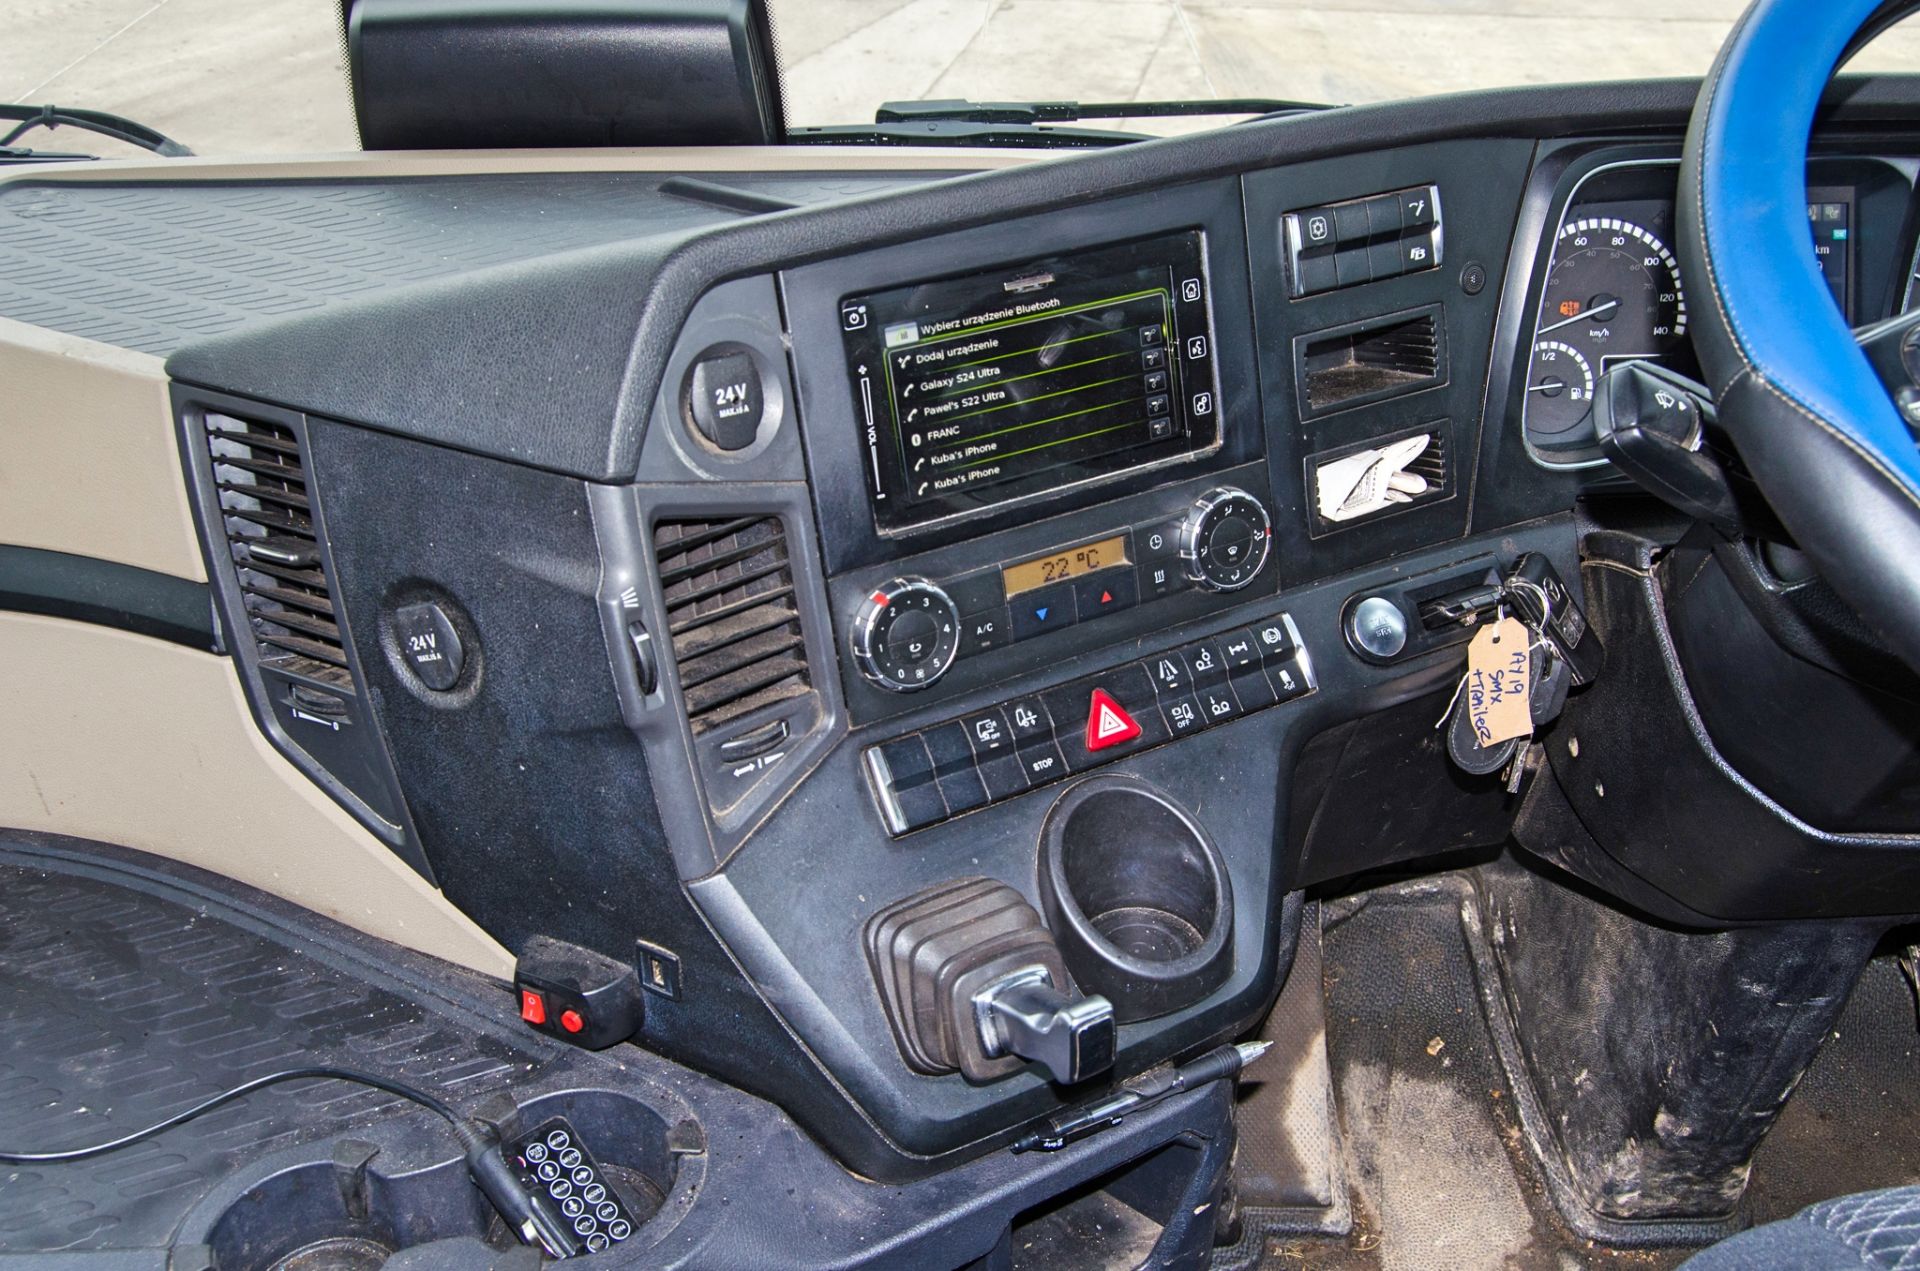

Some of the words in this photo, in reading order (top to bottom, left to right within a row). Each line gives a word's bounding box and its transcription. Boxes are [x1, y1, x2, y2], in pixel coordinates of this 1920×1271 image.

[1574, 236, 1588, 246] 60
[1611, 236, 1625, 246] 80
[1815, 244, 1830, 254] km
[1643, 257, 1660, 266] 100
[1659, 293, 1675, 302] 120
[920, 319, 961, 336] Wybierz
[962, 308, 1014, 325] urządzenie
[1015, 298, 1061, 315] Bluetooth
[1589, 327, 1610, 337] km/h
[1653, 326, 1669, 336] 140
[916, 349, 945, 364] Dodaj
[947, 338, 999, 357] urządzenie
[1541, 352, 1556, 361] 1/2
[920, 376, 954, 392] Galaxy
[956, 370, 975, 384] S24
[977, 367, 1001, 379] Ultra
[714, 382, 747, 406] 24V
[961, 395, 980, 408] S22
[981, 390, 1006, 403] Ultra
[867, 425, 877, 446] VOL
[927, 425, 961, 441] FRANC
[930, 451, 963, 466] Kuba's
[964, 442, 998, 457] iPhone
[933, 475, 967, 490] Kuba's
[968, 466, 1001, 481] iPhone
[1041, 557, 1070, 583] 22
[922, 597, 930, 607] 3
[889, 607, 896, 617] 2
[943, 623, 951, 633] 4
[976, 622, 994, 635] A/C
[410, 632, 436, 651] 24V
[878, 643, 884, 653] 1
[933, 658, 940, 668] 5
[897, 668, 905, 679] 0
[1488, 669, 1505, 705] SMX
[1176, 718, 1191, 729] OFF
[1032, 758, 1054, 772] STOP
